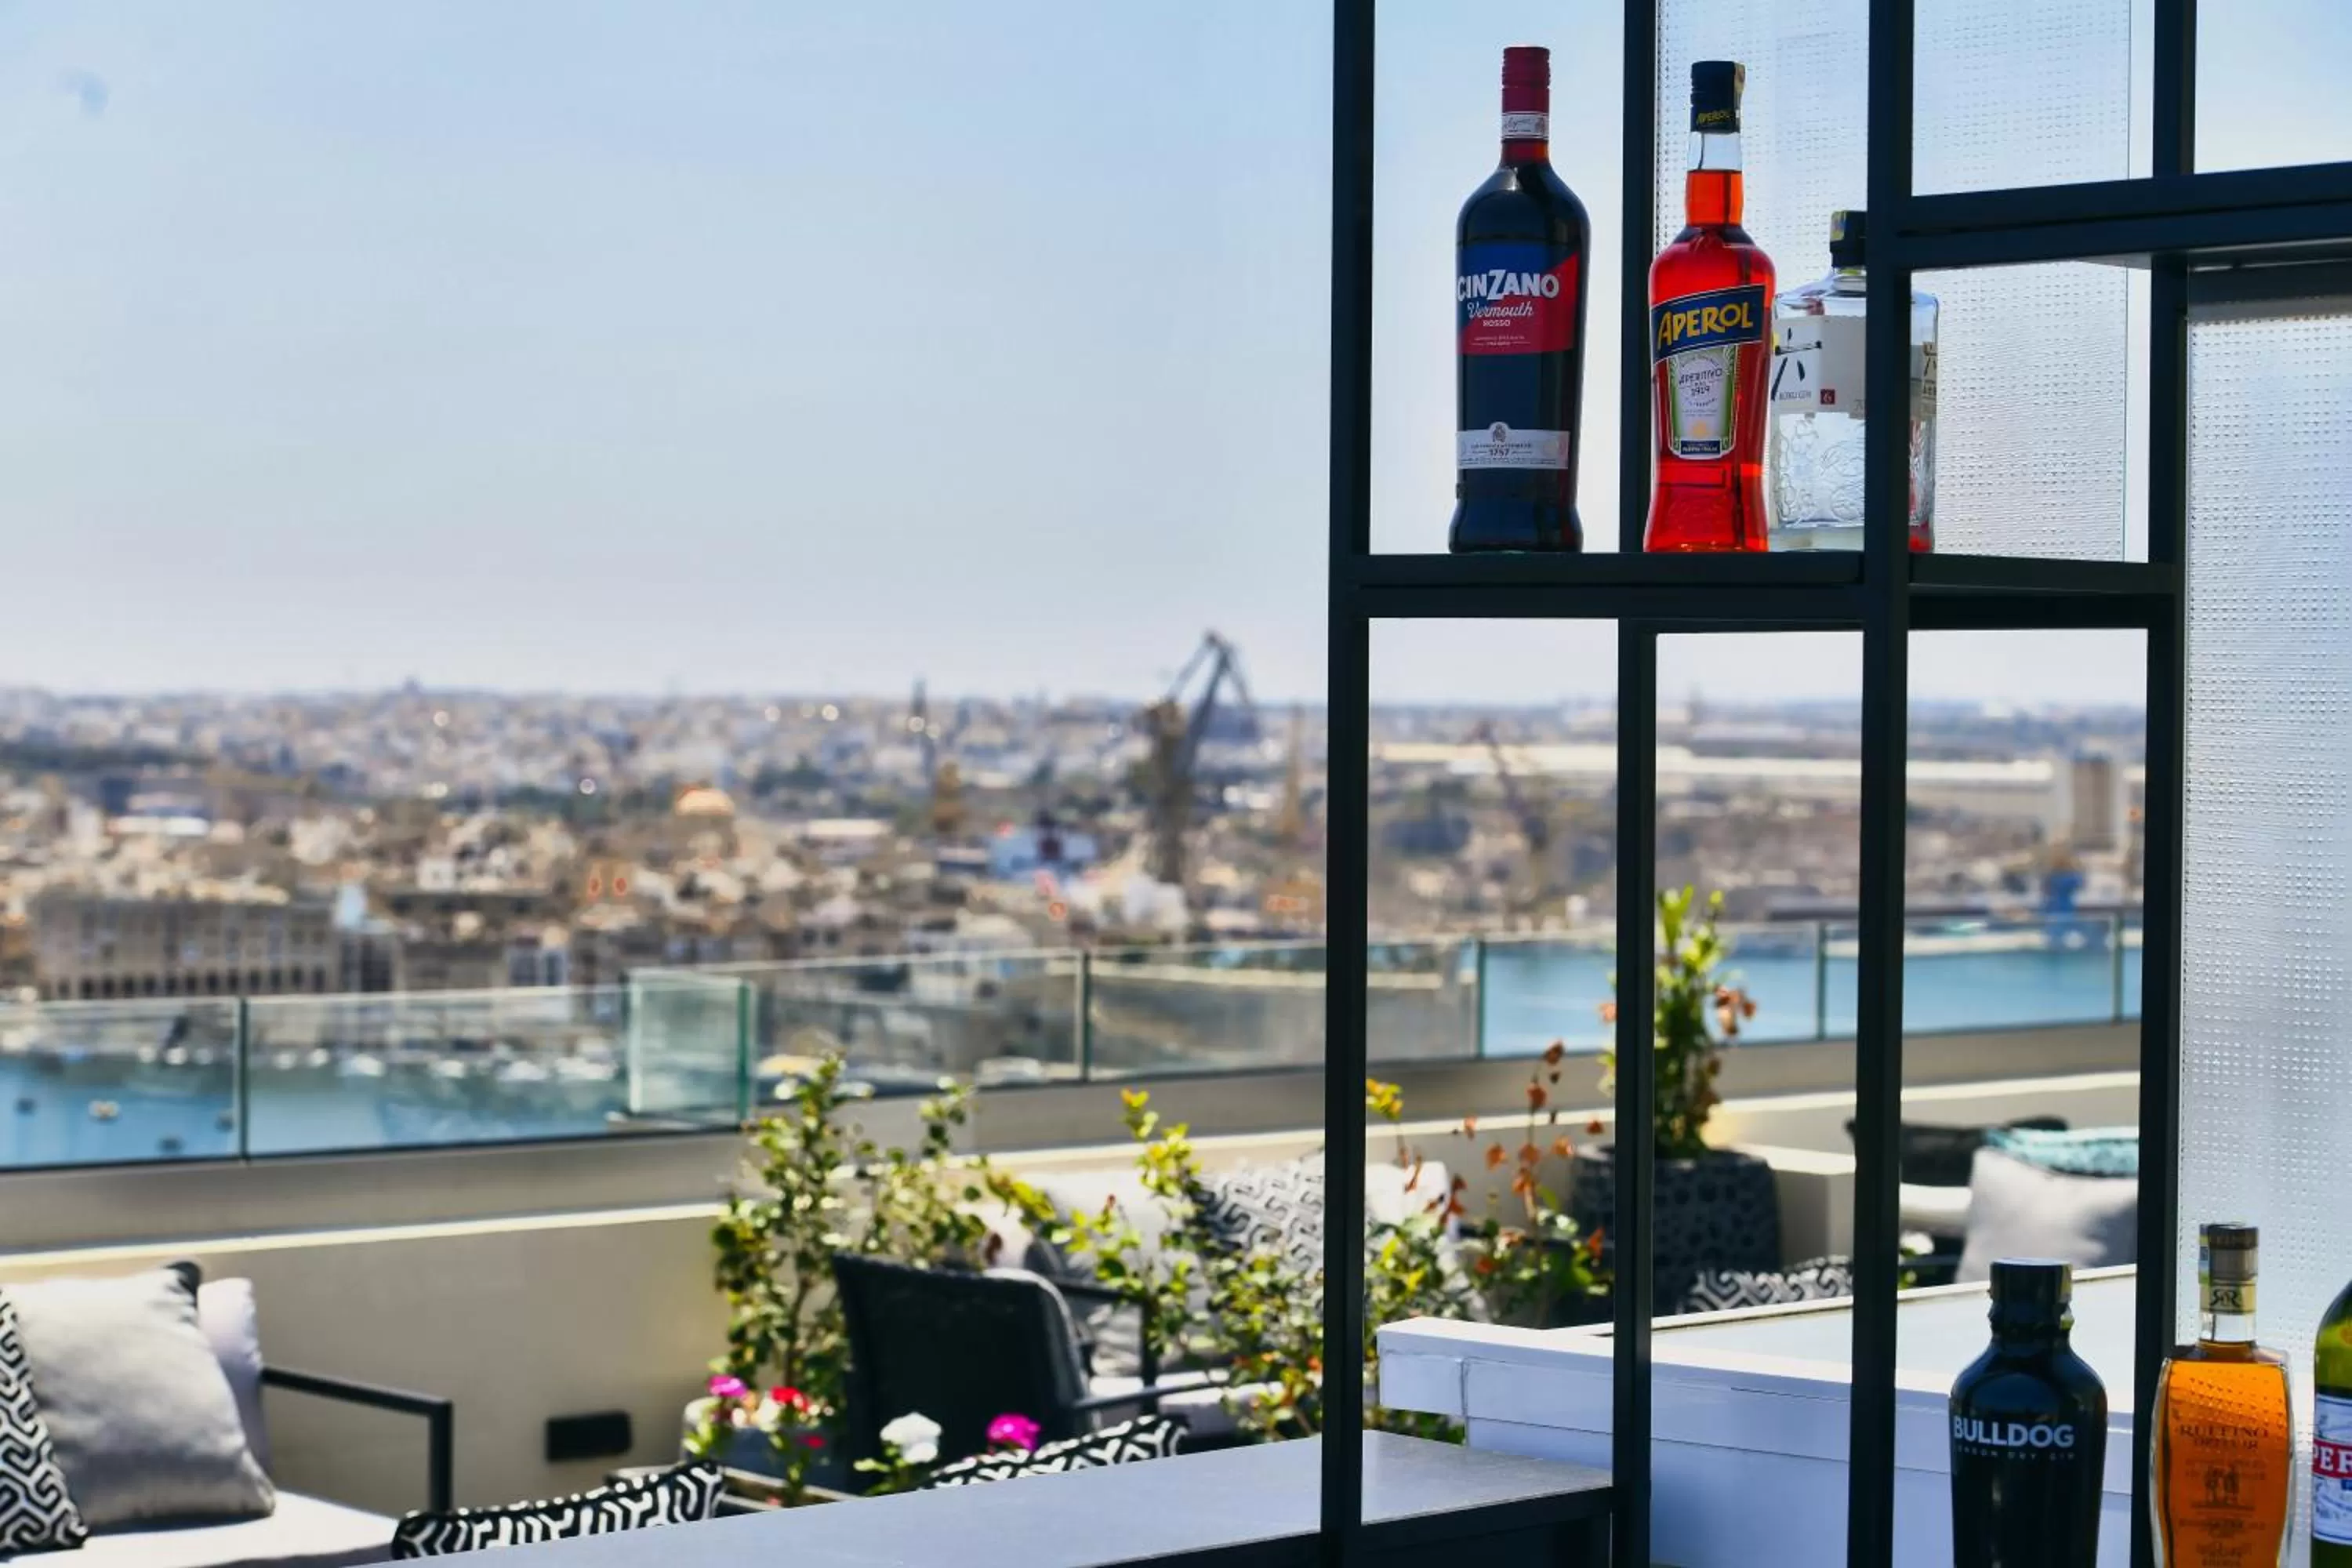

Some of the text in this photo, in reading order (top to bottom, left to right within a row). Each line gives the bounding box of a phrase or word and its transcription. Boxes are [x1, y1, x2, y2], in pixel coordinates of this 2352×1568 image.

[1457, 270, 1559, 301] CINZANO
[1467, 301, 1534, 318] Vermouth
[1657, 302, 1754, 351] APEROL
[1954, 1415, 2075, 1448] BULLDOG
